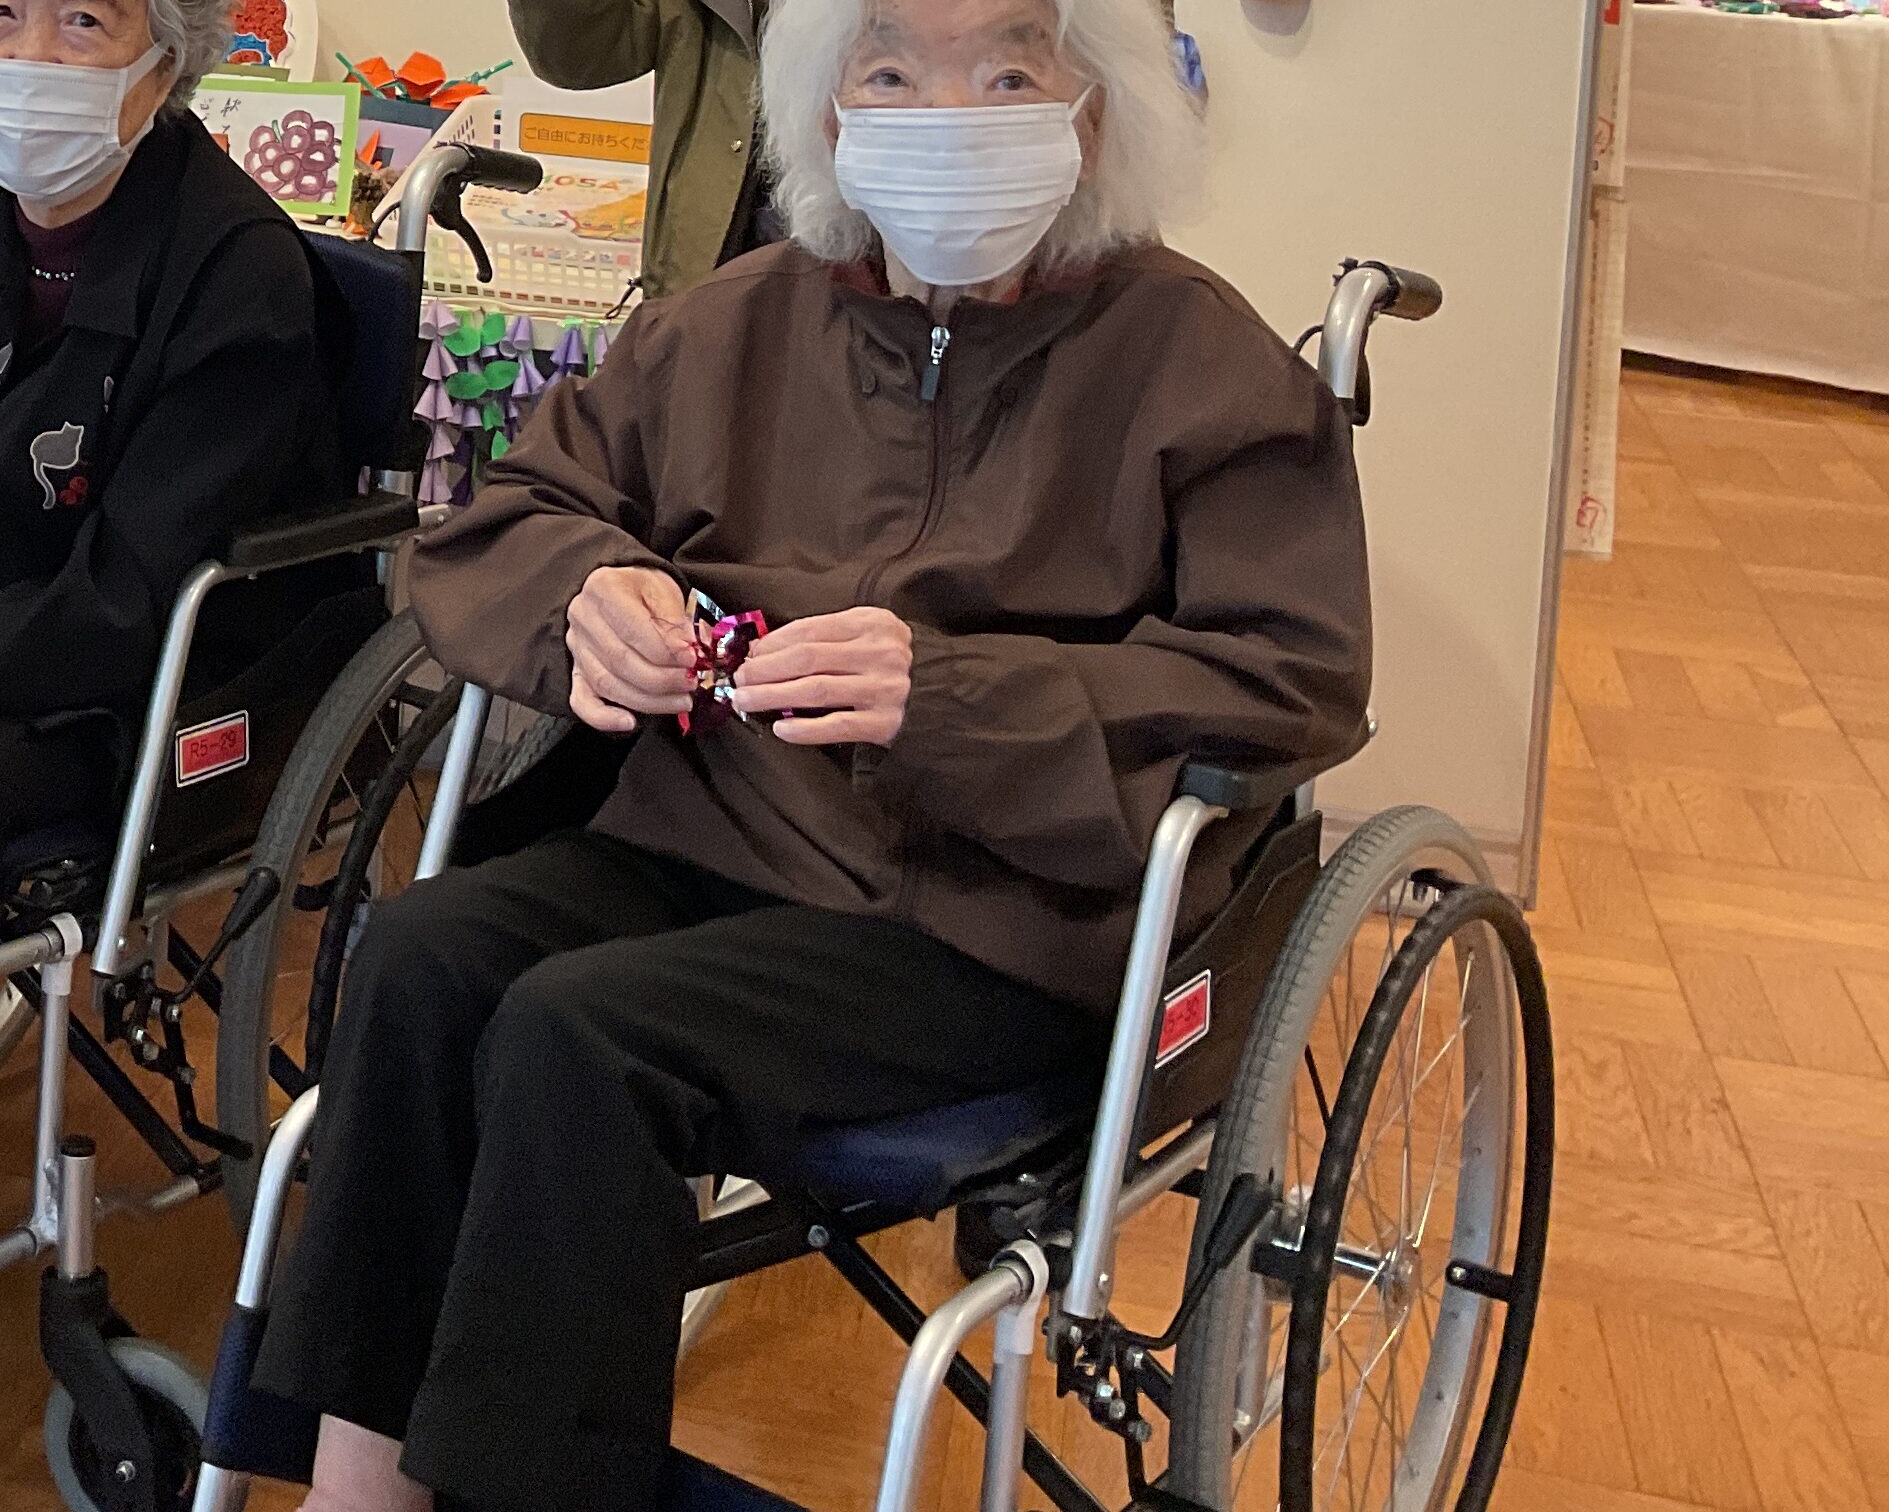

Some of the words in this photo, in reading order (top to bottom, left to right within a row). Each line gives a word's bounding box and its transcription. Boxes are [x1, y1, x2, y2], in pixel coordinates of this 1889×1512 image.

[524, 126, 649, 151] ご自由にお持ちくだ
